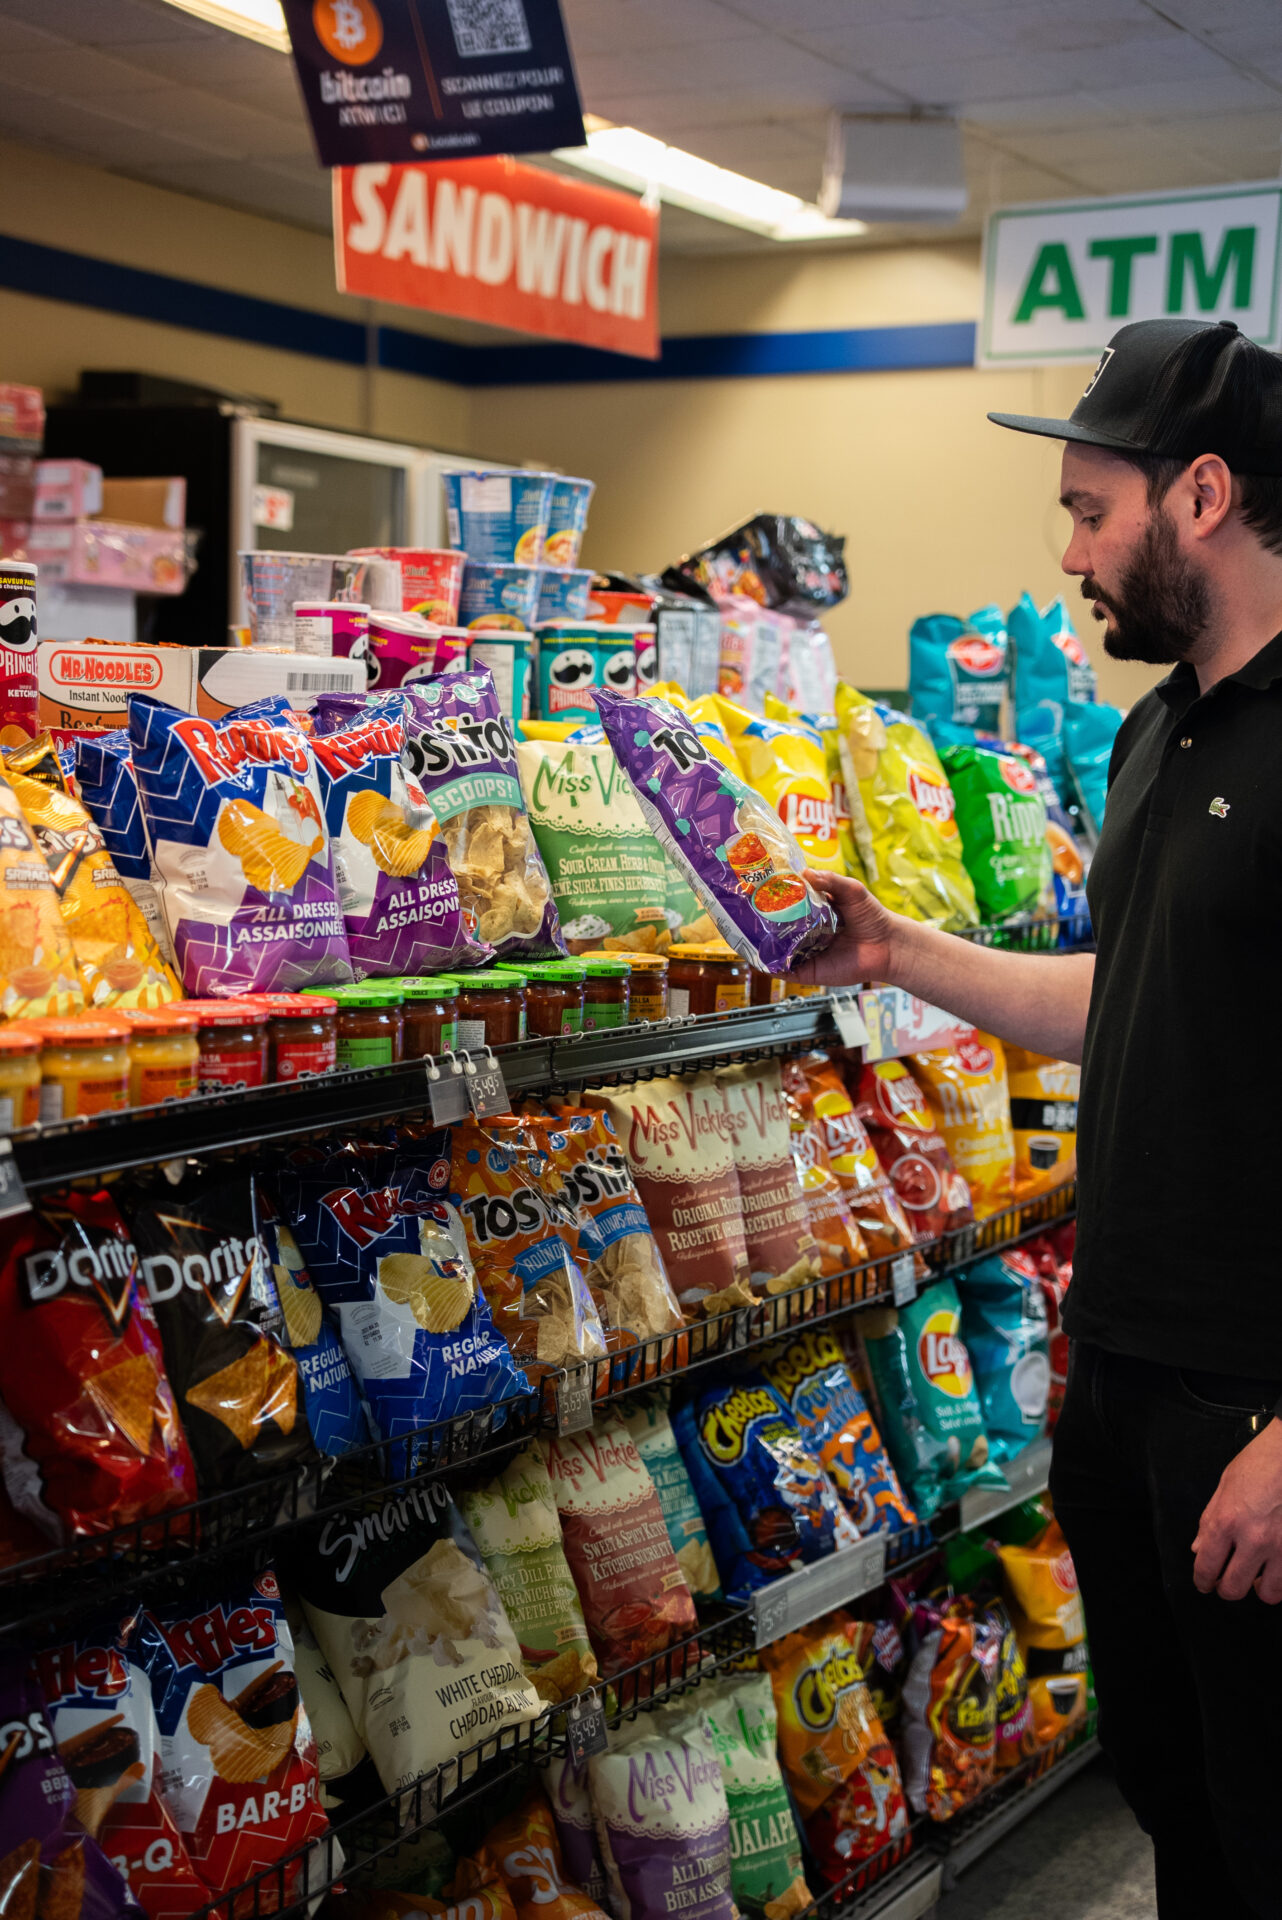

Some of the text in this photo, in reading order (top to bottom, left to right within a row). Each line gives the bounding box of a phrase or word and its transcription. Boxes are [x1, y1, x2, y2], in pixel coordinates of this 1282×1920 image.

[320, 69, 412, 104] bitcoin
[346, 162, 651, 321] SANDWICH
[1011, 226, 1256, 325] ATM
[69, 690, 99, 702] Instant
[432, 778, 514, 815] SCOOPS!
[532, 751, 591, 813] Miss
[560, 858, 586, 875] SOUR
[251, 905, 287, 924] ALL
[388, 891, 416, 912] ALL
[629, 1104, 679, 1165] Miss
[672, 1201, 722, 1228] ORIGINAL
[667, 1223, 723, 1252] RECETTE
[703, 1388, 780, 1462] Cheetos
[583, 1536, 617, 1560] SWEET
[620, 1525, 646, 1546] SPICY
[518, 1567, 546, 1585] DILL
[589, 1553, 635, 1582] KETCHUP
[435, 1674, 482, 1708] WHITE
[449, 1700, 504, 1740] CHEDDAR
[627, 1752, 675, 1823] Miss
[672, 1863, 698, 1886] ALL
[664, 1887, 698, 1912] BIEN
